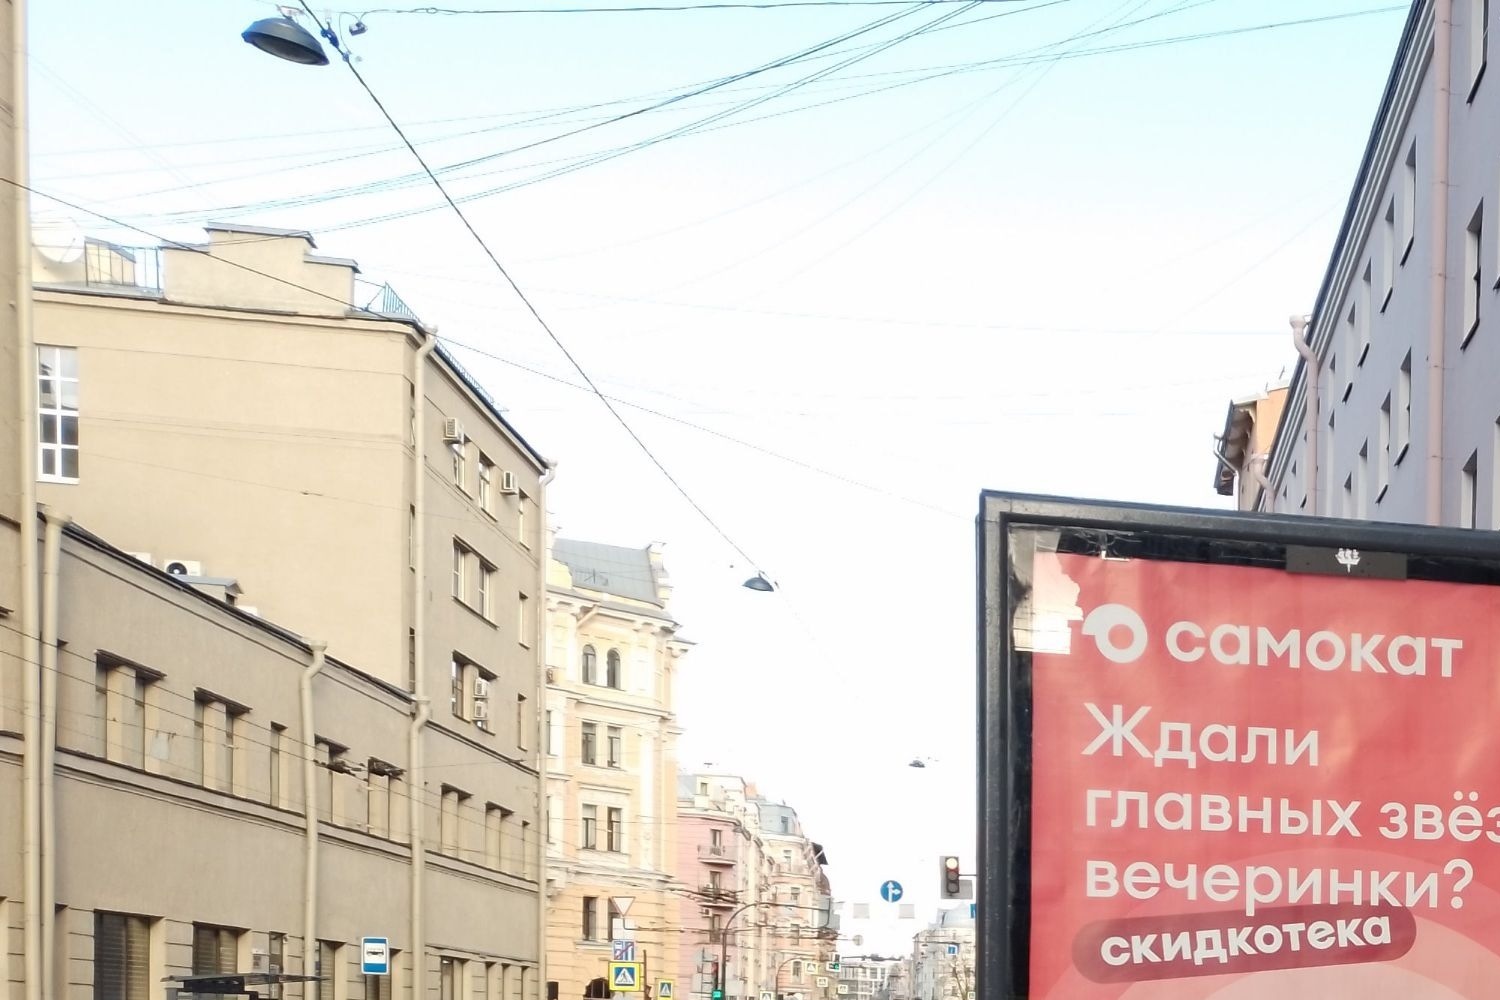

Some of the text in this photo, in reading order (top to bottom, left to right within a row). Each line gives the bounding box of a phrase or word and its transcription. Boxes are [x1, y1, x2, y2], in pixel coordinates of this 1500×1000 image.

[1165, 620, 1463, 678] самокат
[1081, 702, 1320, 769] Ждали
[1085, 788, 1362, 838] главных
[1085, 857, 1474, 917] вечеринки?
[1100, 915, 1392, 966] скидкотека
